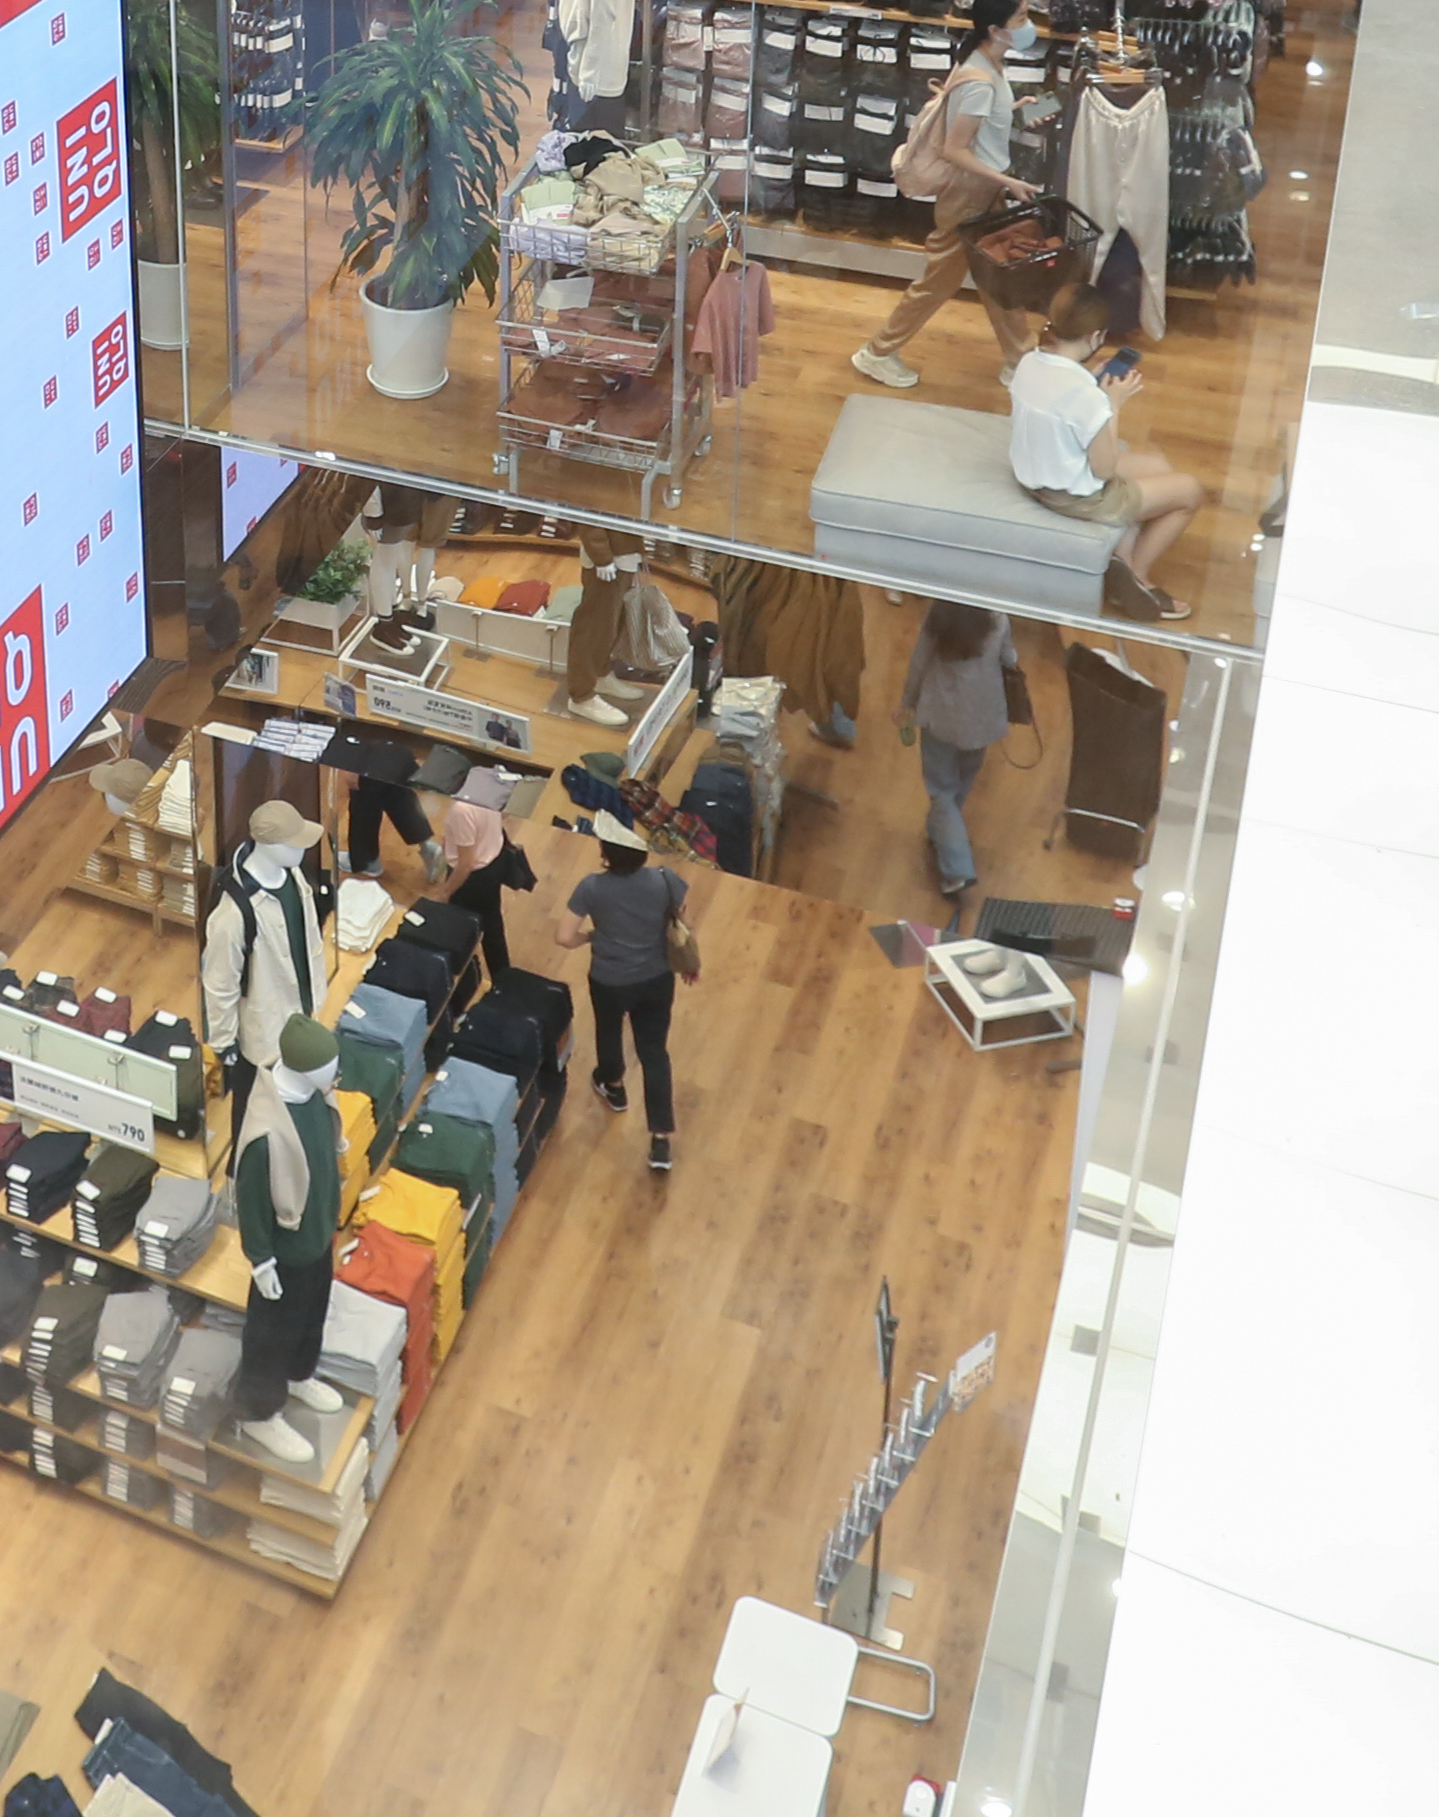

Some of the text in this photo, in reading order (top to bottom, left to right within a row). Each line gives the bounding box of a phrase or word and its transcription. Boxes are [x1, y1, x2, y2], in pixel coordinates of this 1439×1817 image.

[65, 124, 89, 221] UNI
[90, 101, 116, 199] QLO
[96, 340, 110, 396] UNI
[110, 325, 126, 382] QLO
